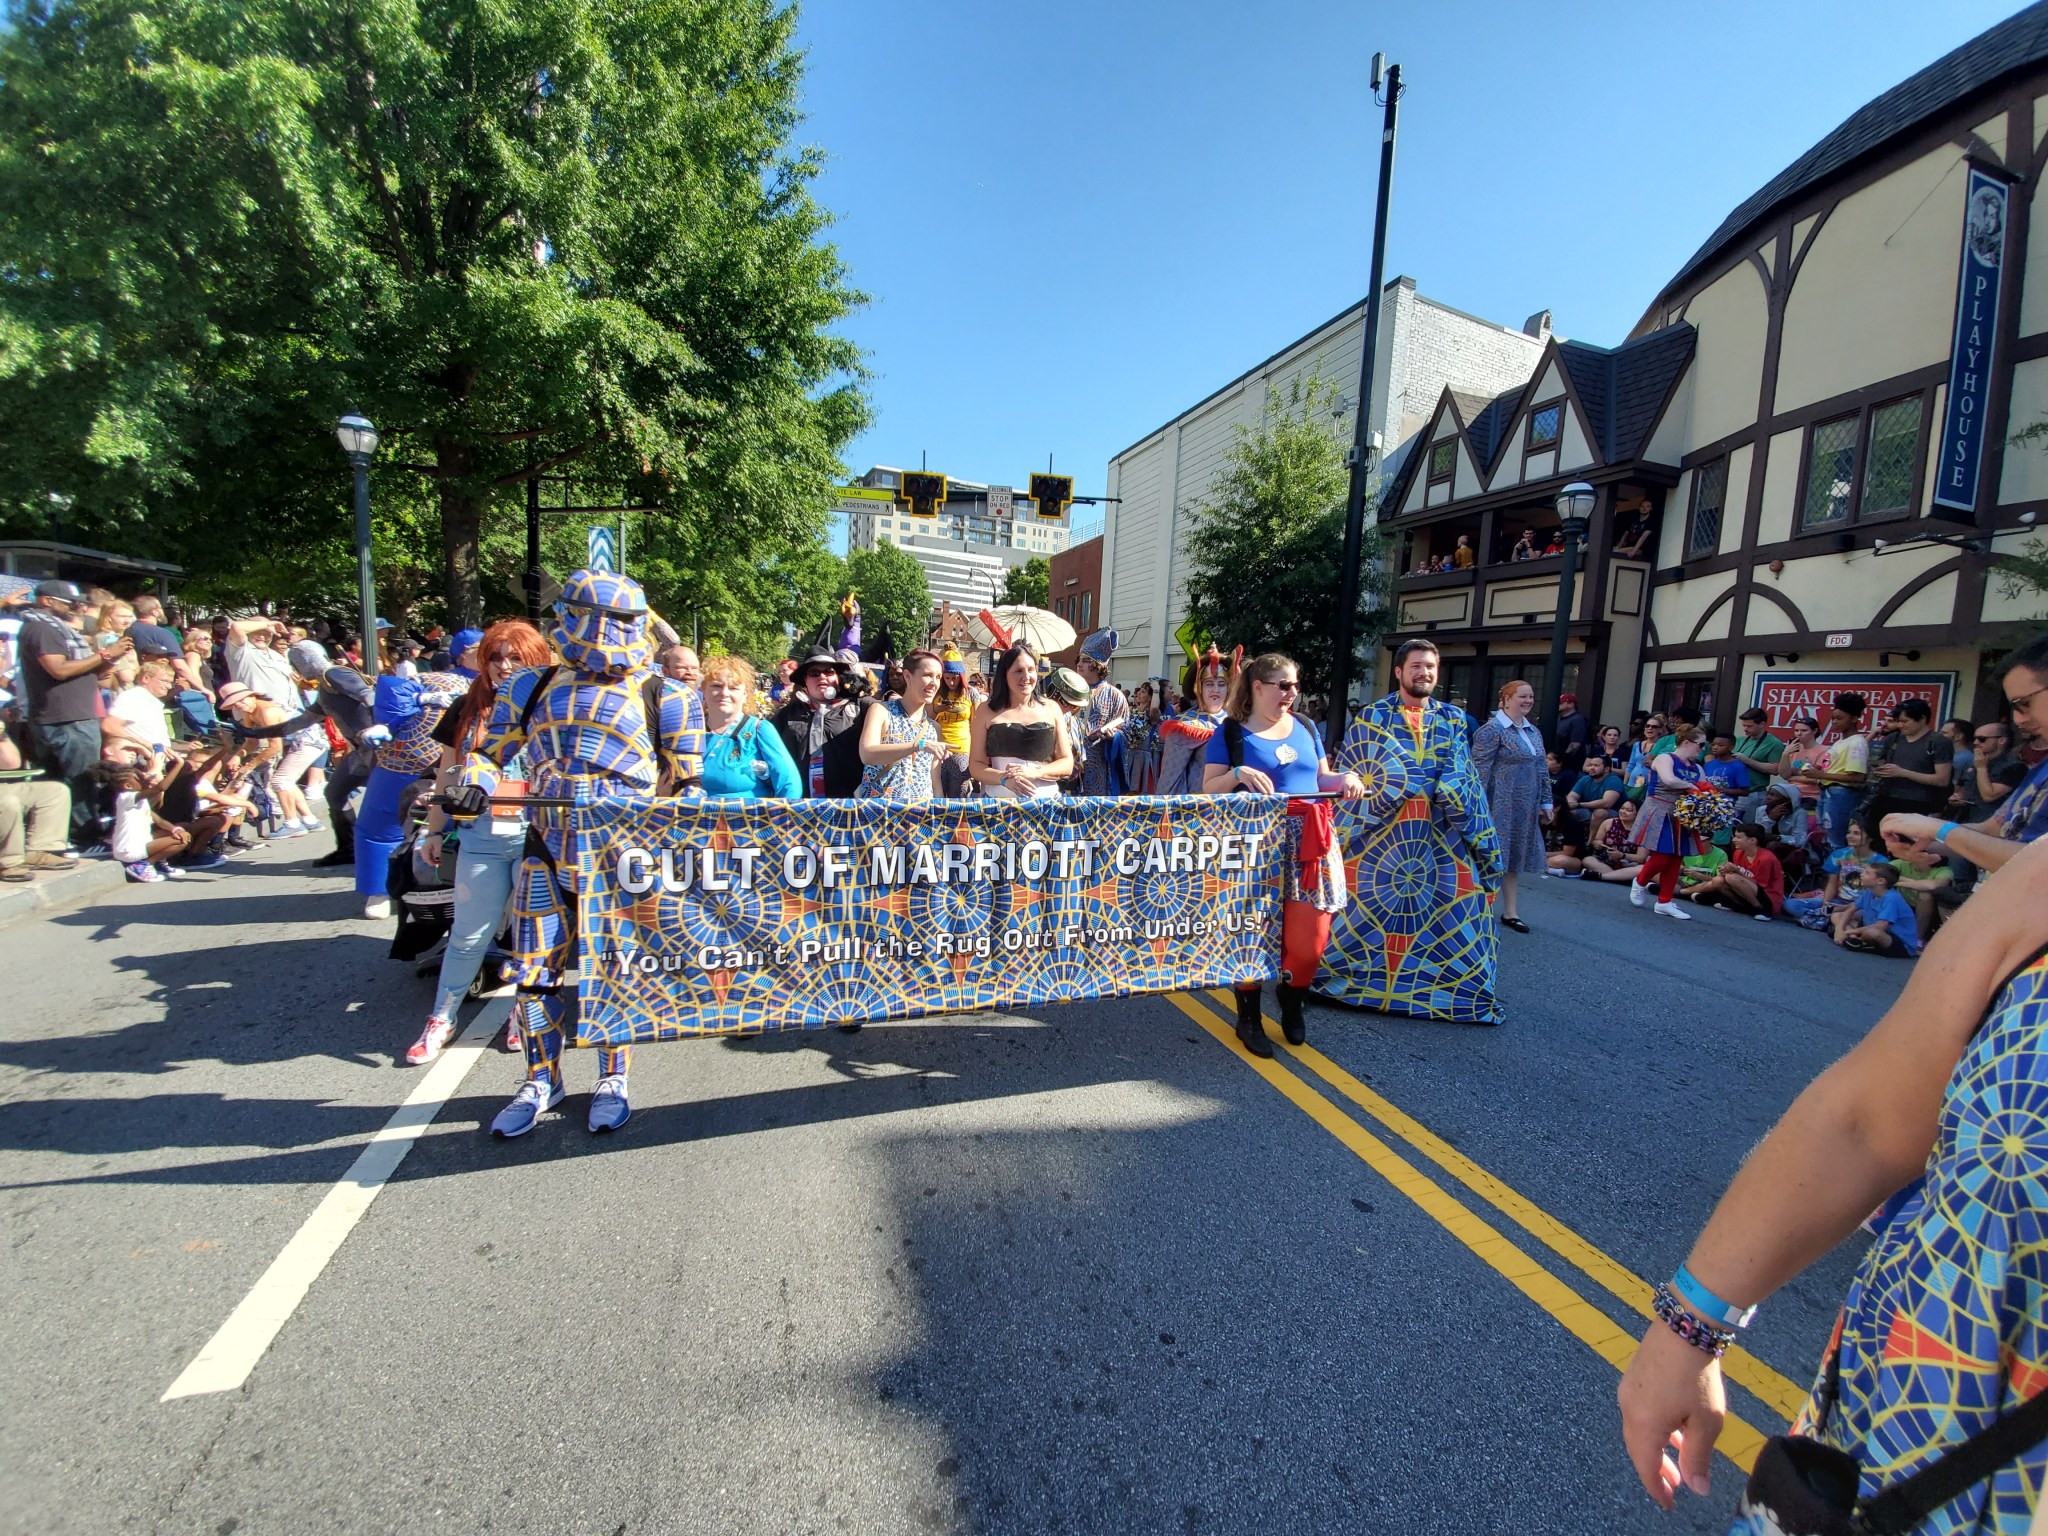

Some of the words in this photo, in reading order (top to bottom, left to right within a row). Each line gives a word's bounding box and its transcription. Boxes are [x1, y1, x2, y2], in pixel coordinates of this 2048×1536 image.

[1951, 275, 1987, 489] PLAYHOUSE
[1830, 636, 1847, 645] FDC
[1767, 688, 1932, 706] SHAKEPEARE
[1766, 704, 1894, 745] TAVER
[617, 846, 761, 894] CULT
[783, 845, 851, 889] OF
[871, 839, 1100, 885] MARRIOTT
[1116, 833, 1264, 875] CARPET
[602, 949, 682, 975] "You
[697, 943, 788, 970] Can't
[801, 937, 861, 963] Pull
[874, 935, 922, 959] the
[936, 933, 991, 958] Rug
[1003, 928, 1054, 951] Out
[1064, 924, 1132, 946] From
[1145, 917, 1217, 940] Under
[1226, 910, 1272, 933] Us!"
